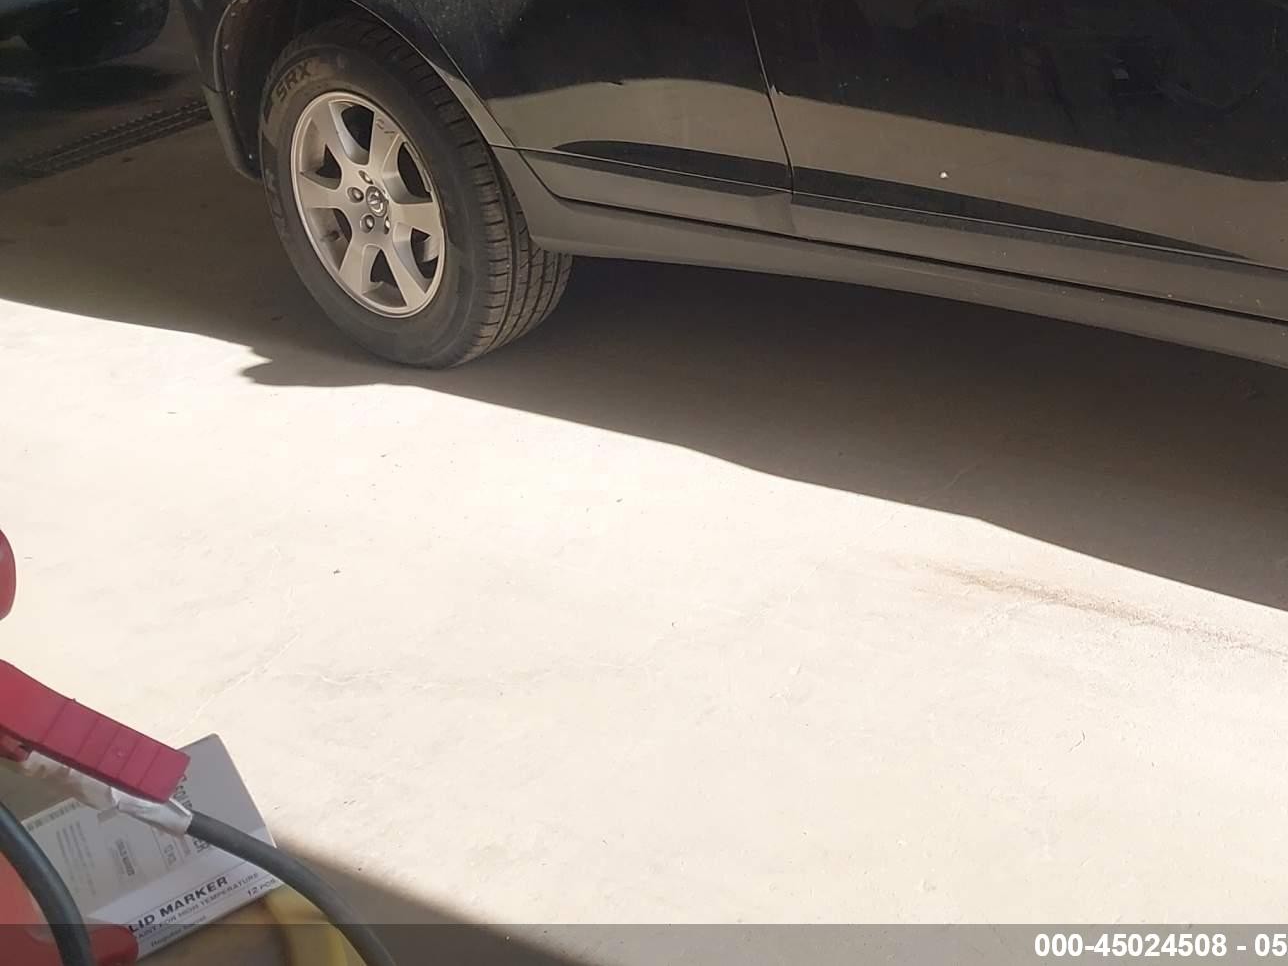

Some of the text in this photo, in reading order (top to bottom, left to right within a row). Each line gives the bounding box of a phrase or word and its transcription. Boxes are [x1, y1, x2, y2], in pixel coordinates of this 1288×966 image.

[128, 914, 155, 933] LID
[159, 875, 228, 917] MARKER
[247, 886, 258, 898] 12
